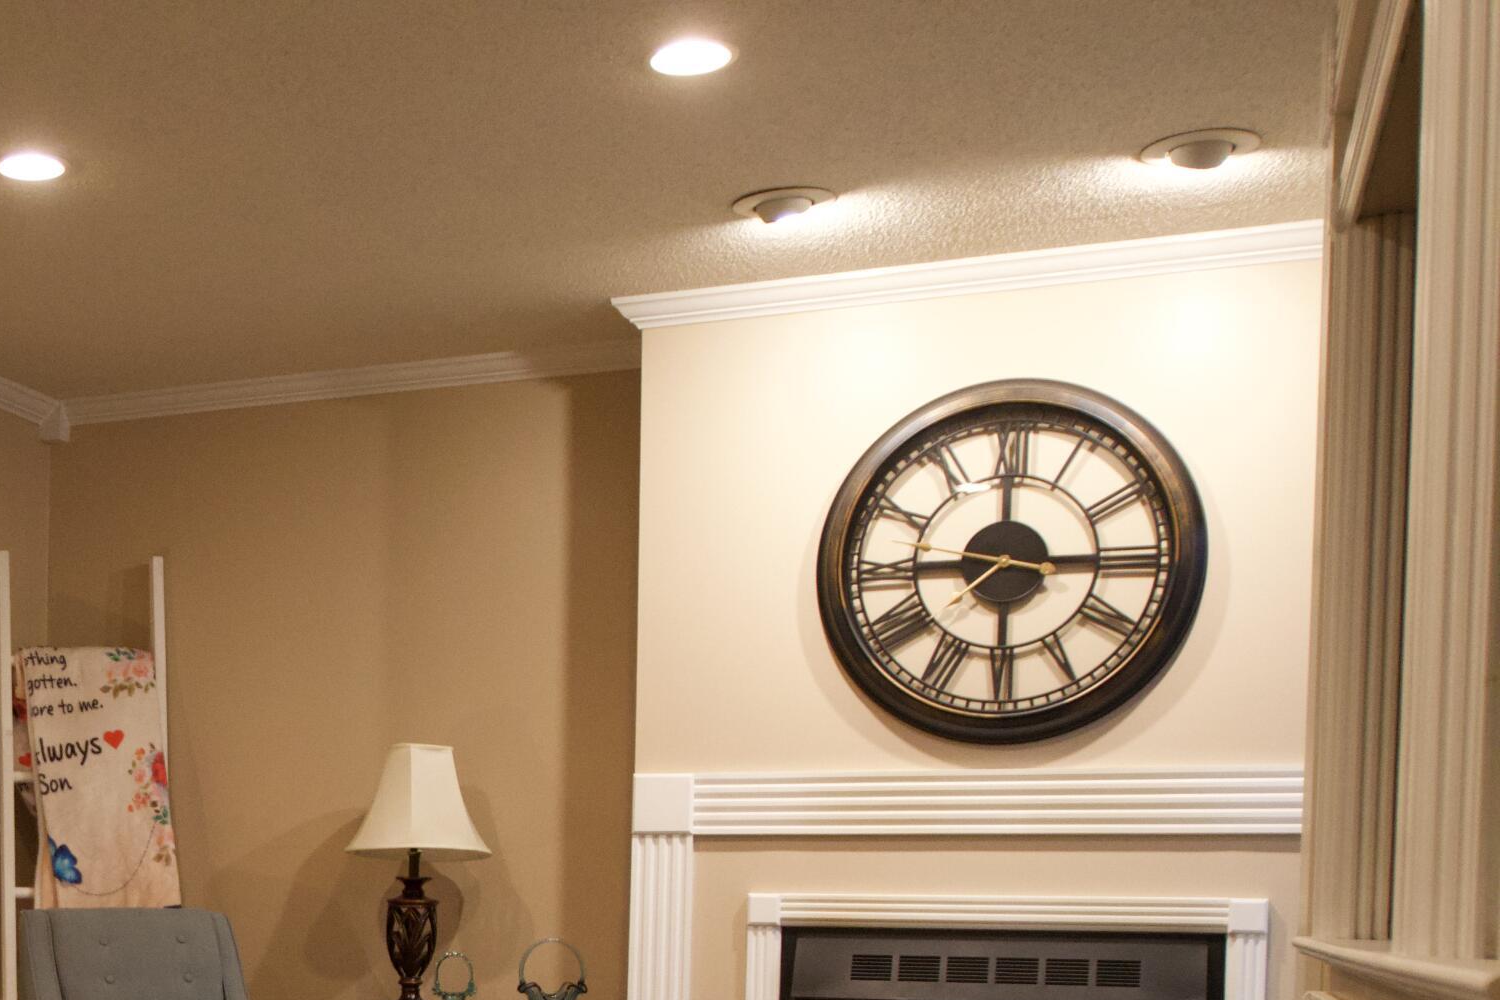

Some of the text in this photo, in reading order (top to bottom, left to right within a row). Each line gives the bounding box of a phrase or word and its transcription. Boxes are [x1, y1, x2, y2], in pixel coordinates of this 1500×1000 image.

[58, 699, 74, 714] to
[79, 699, 103, 712] me.
[38, 773, 72, 795] Son
